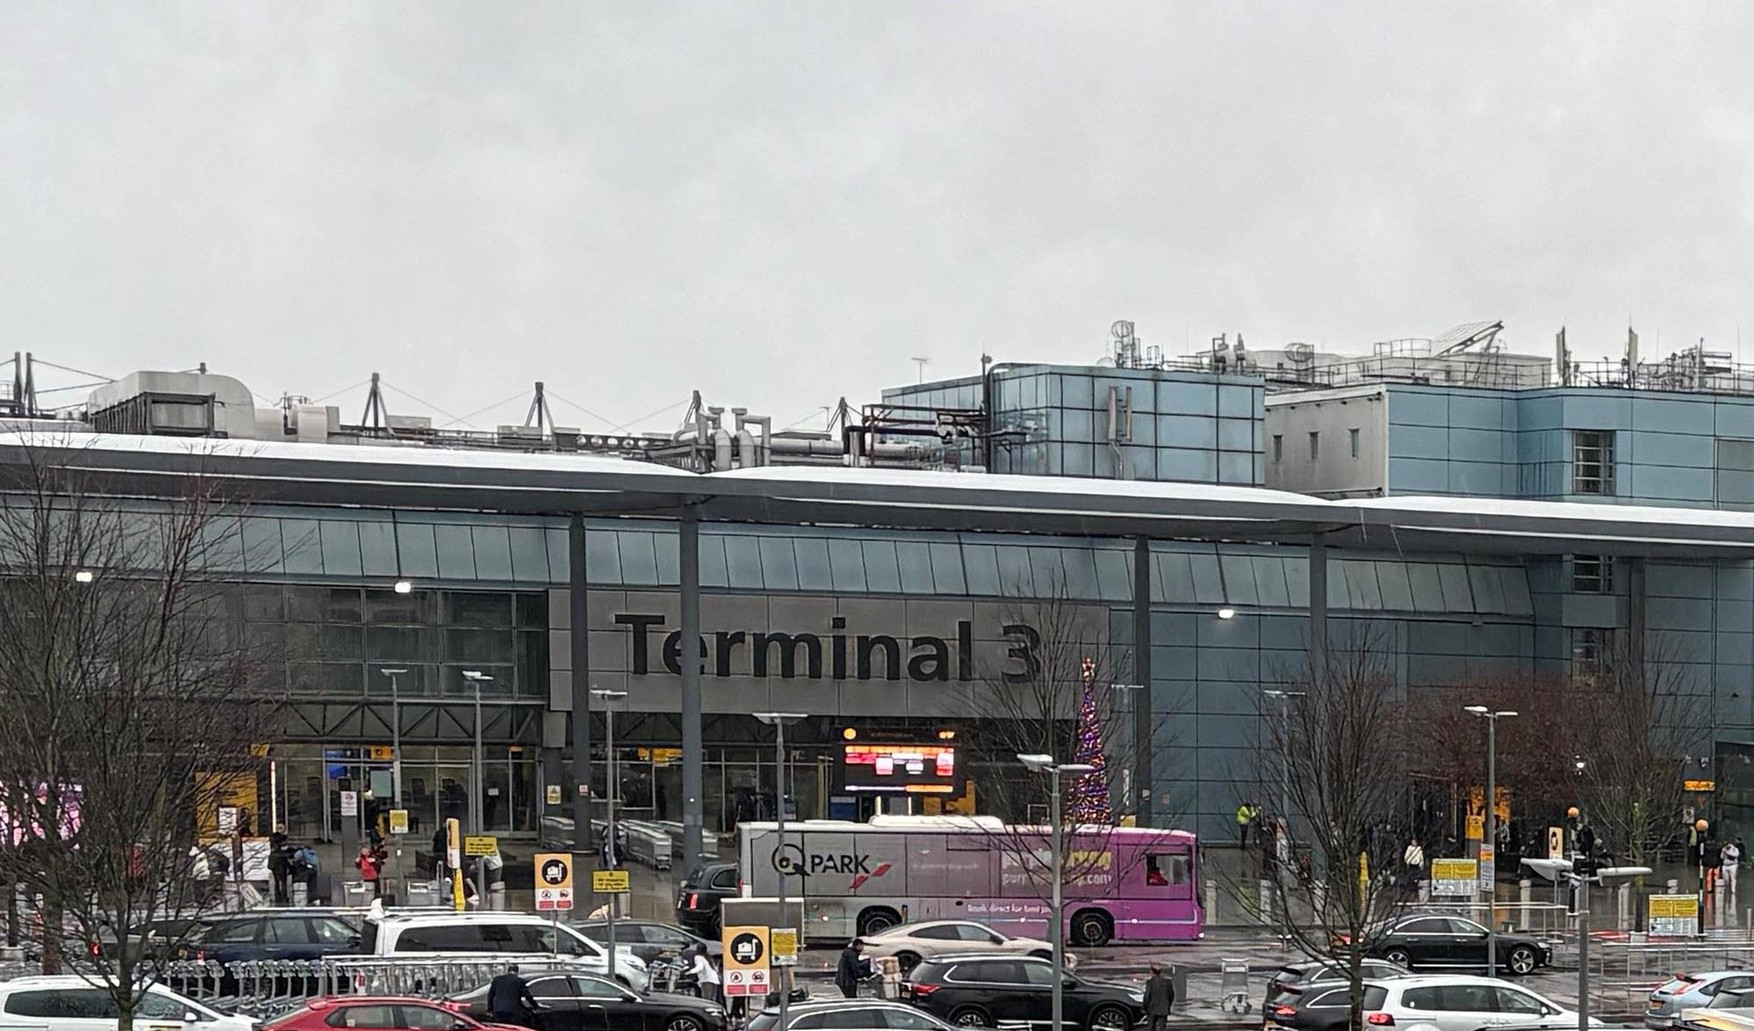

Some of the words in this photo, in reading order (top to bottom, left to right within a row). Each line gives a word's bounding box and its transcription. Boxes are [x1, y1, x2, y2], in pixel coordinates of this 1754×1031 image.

[614, 614, 972, 682] Terminal
[1002, 624, 1041, 682] 3
[810, 854, 871, 875] PARK
